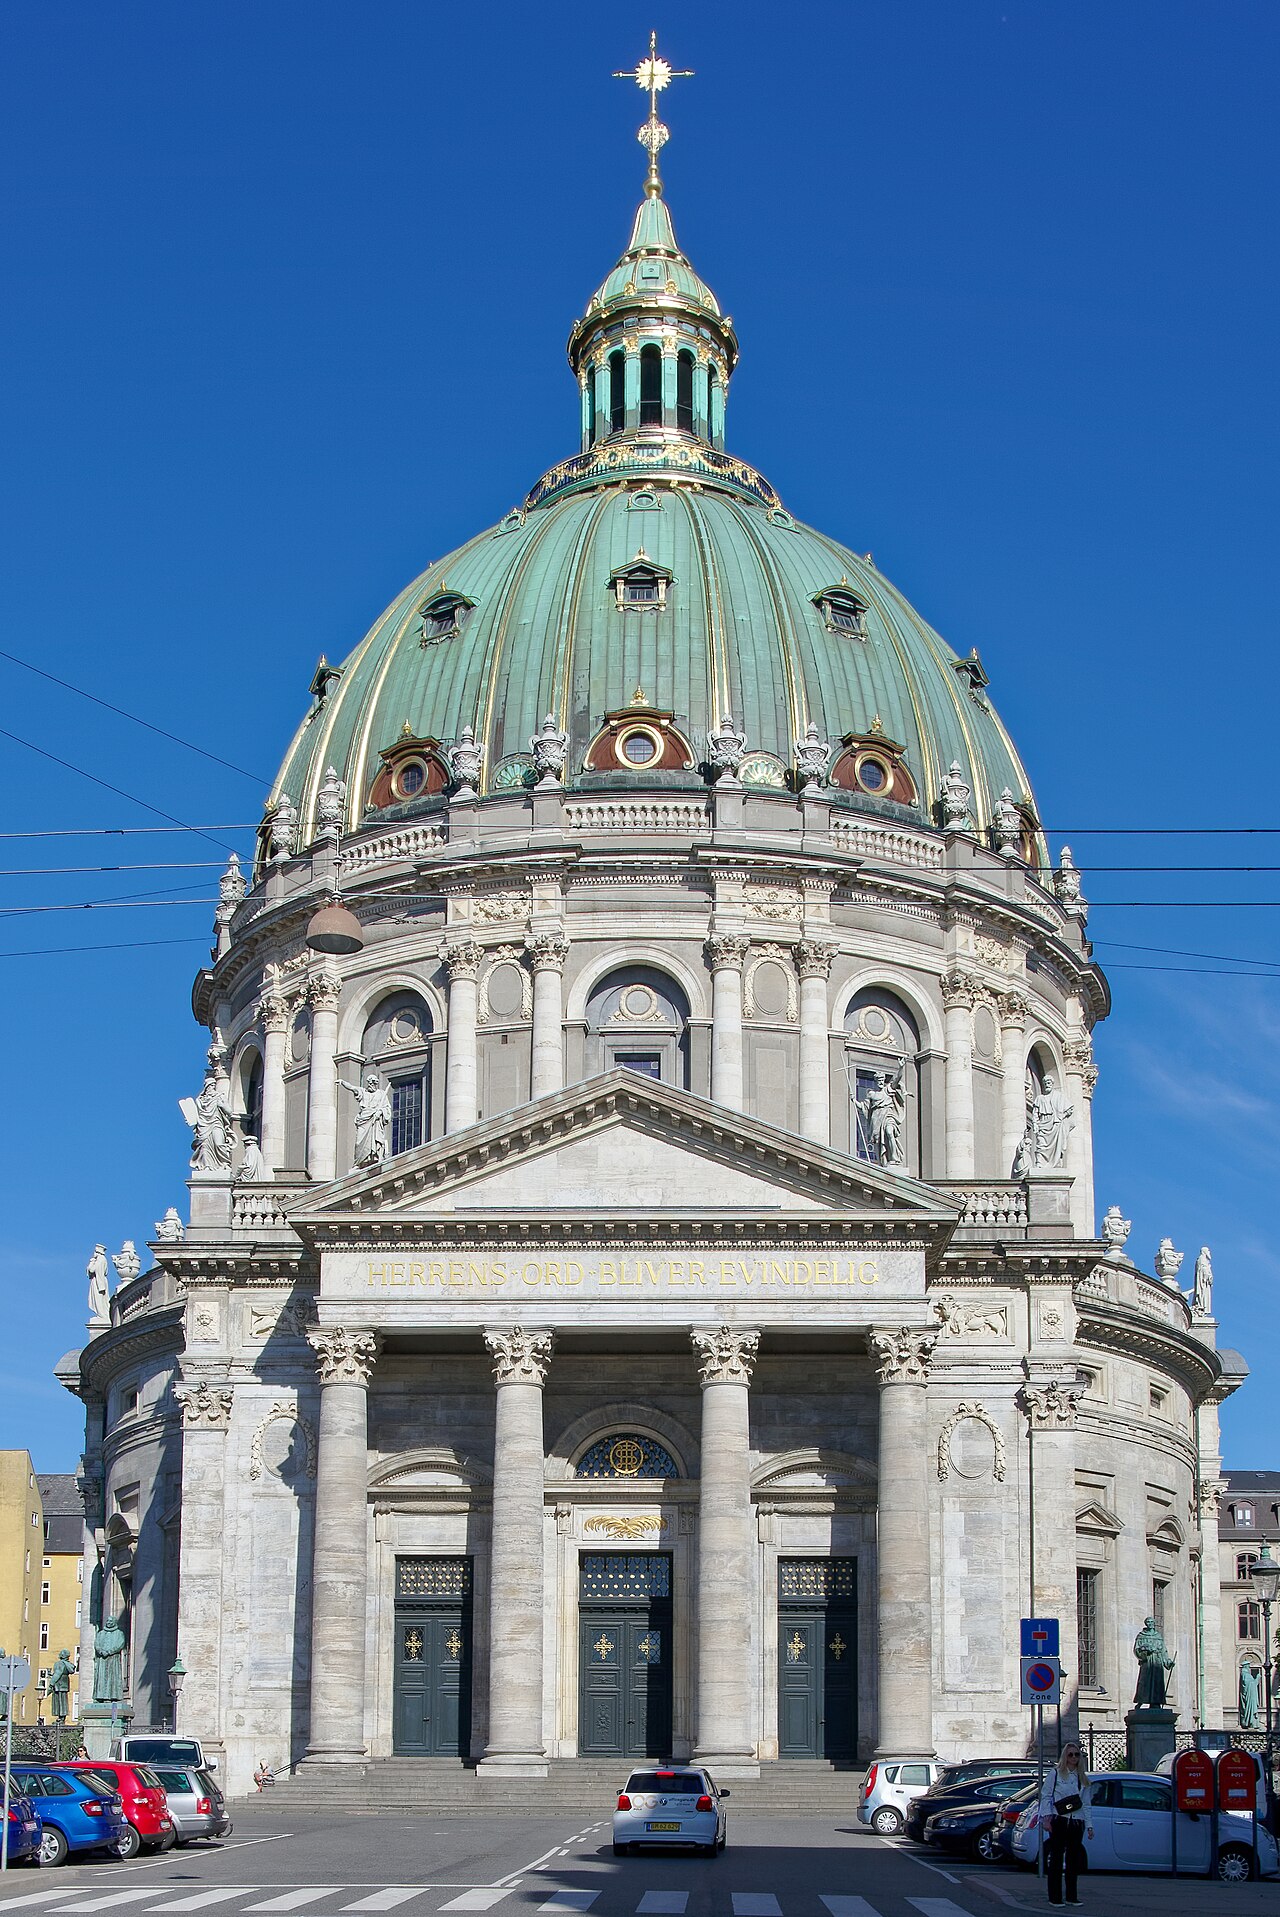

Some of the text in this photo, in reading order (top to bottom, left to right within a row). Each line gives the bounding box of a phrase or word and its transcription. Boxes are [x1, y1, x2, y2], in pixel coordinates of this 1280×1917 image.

[367, 1260, 880, 1286] HERRENS ORD BLIVER EVINDELIG
